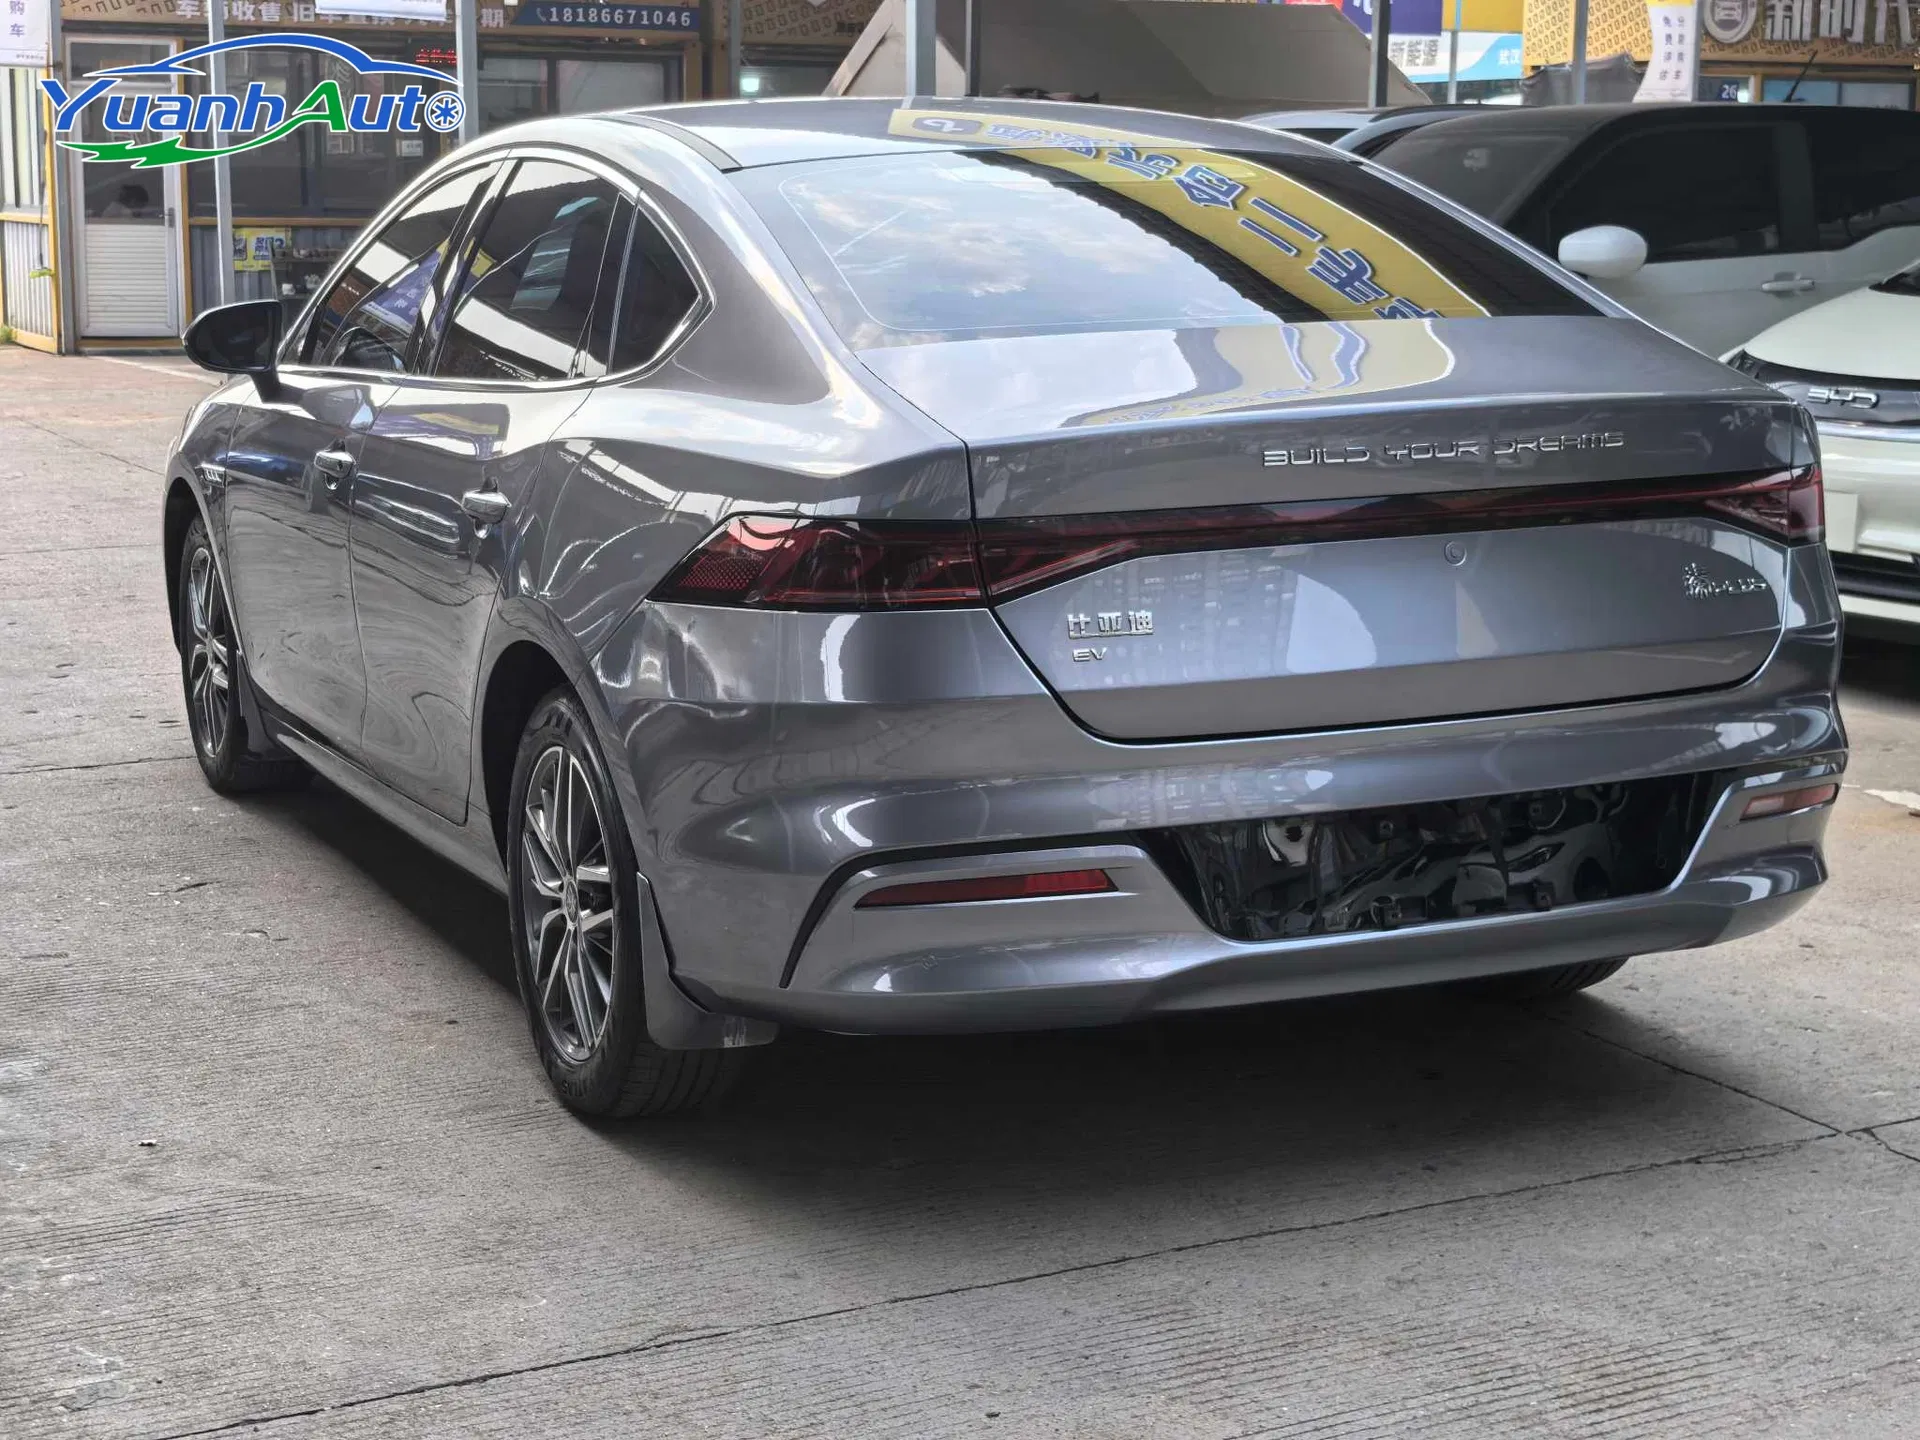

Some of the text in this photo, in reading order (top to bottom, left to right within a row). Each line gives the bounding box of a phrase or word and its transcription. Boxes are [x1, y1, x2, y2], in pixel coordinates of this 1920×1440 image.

[549, 7, 691, 27] 18186671046
[1721, 83, 1738, 99] 26
[1261, 431, 1625, 468] BUILD YOUR DREAMS
[1067, 610, 1155, 639] 比亚迪
[1073, 646, 1108, 663] EV
